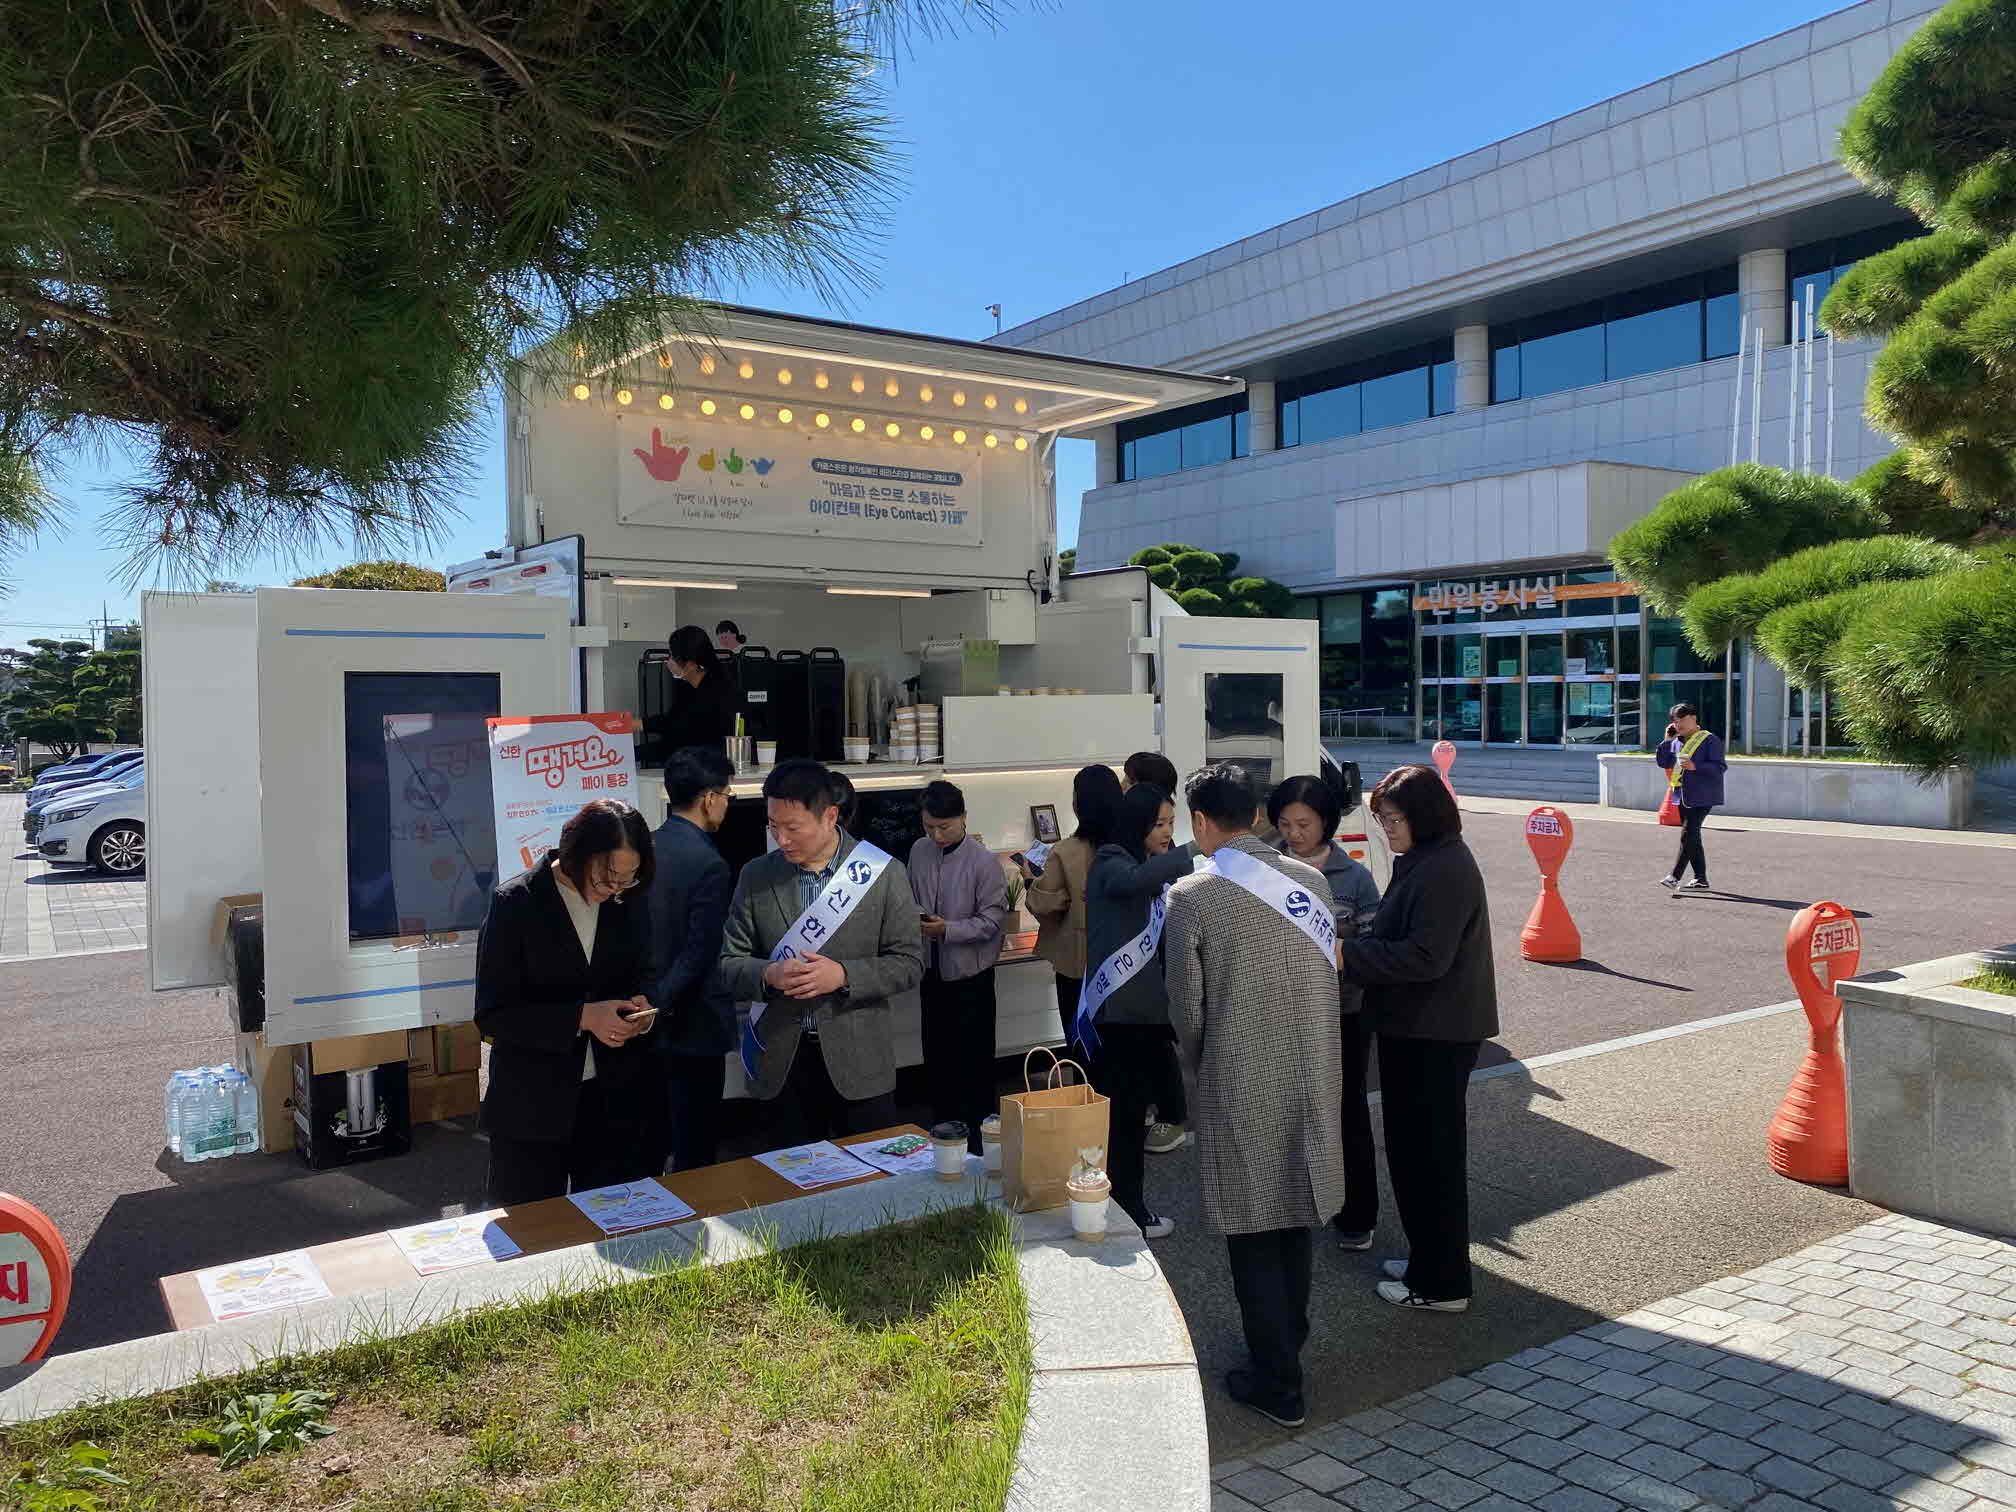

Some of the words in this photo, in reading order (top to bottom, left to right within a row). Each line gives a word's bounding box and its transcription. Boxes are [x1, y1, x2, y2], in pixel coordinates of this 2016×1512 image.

[822, 480, 865, 498] "마음과
[868, 486, 904, 502] 손으로
[908, 490, 956, 506] 소통하는
[809, 499, 861, 517] 아이컨택
[1428, 575, 1557, 616] 민원봉사실
[499, 743, 520, 760] 신한
[582, 774, 604, 790] 페이
[606, 772, 629, 788] 통장
[1530, 820, 1562, 834] 주차금지
[1814, 927, 1855, 953] 주차금지
